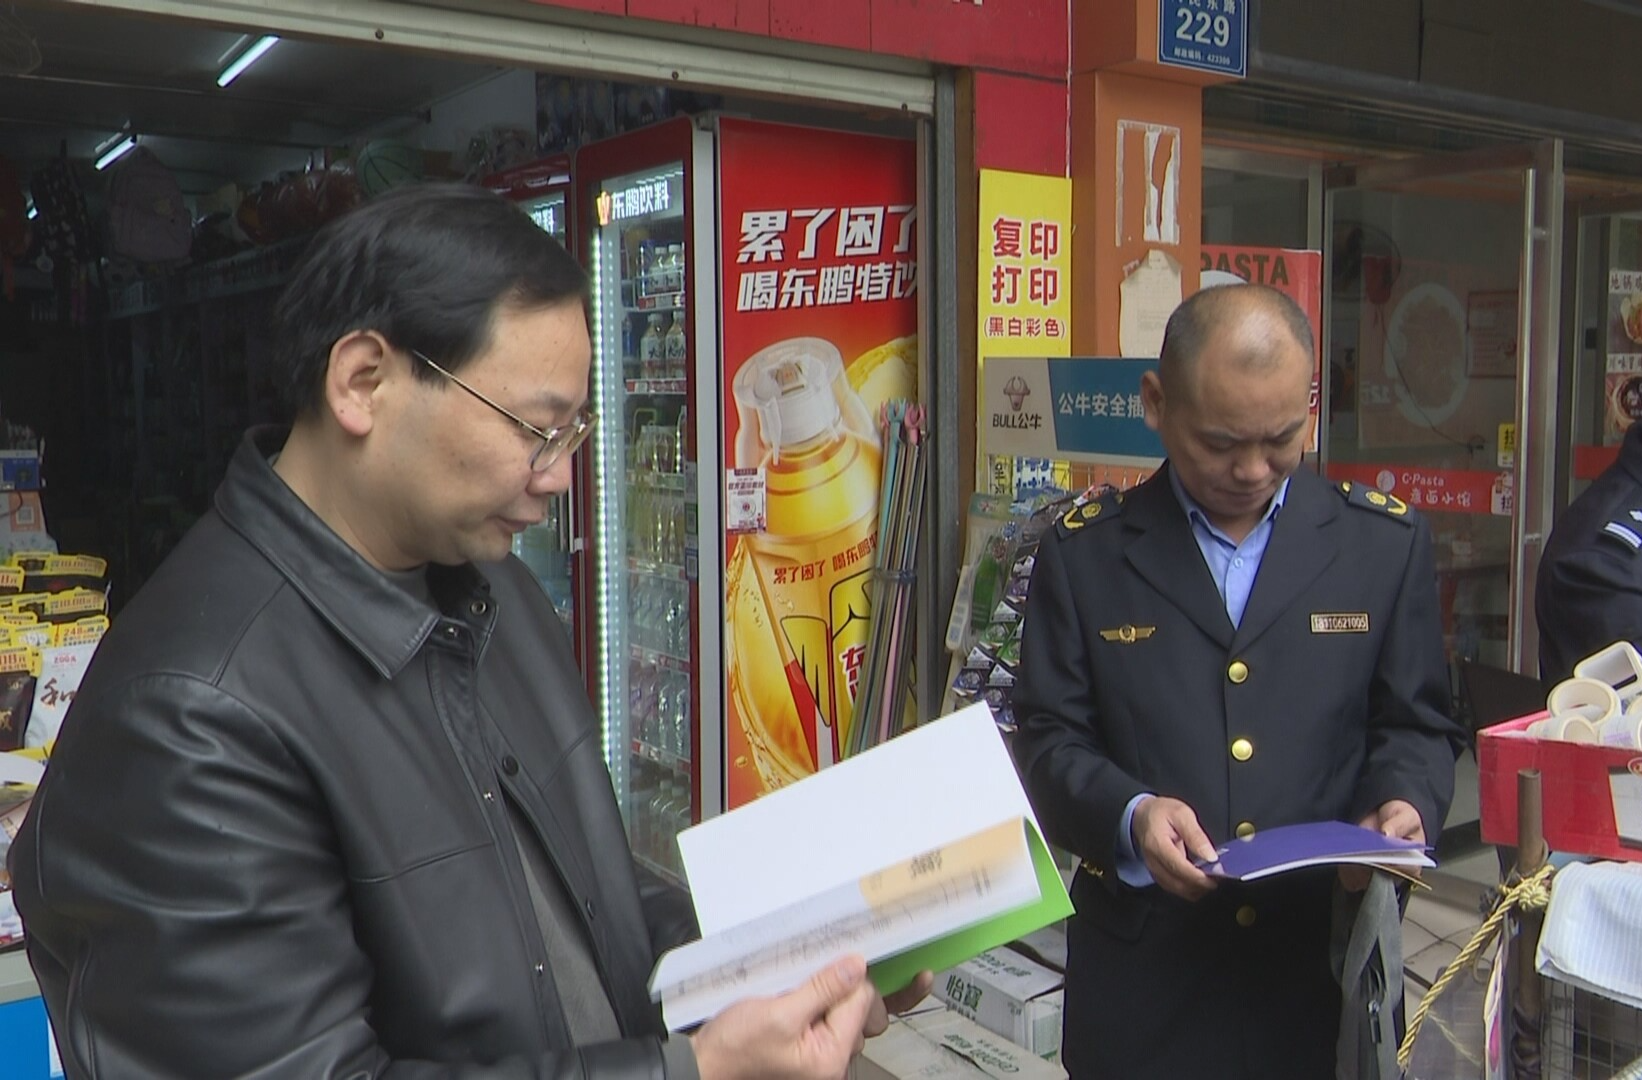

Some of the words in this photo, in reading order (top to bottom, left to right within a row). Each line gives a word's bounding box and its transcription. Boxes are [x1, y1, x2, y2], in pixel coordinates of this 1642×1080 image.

[1176, 7, 1230, 47] 229
[611, 180, 669, 221] 东鹏饮料
[736, 205, 917, 264] 累了困了
[992, 217, 1059, 260] 复印
[736, 261, 917, 313] 喝东鹏特饮
[992, 264, 1058, 306] 打印
[773, 559, 826, 584] 累了困了
